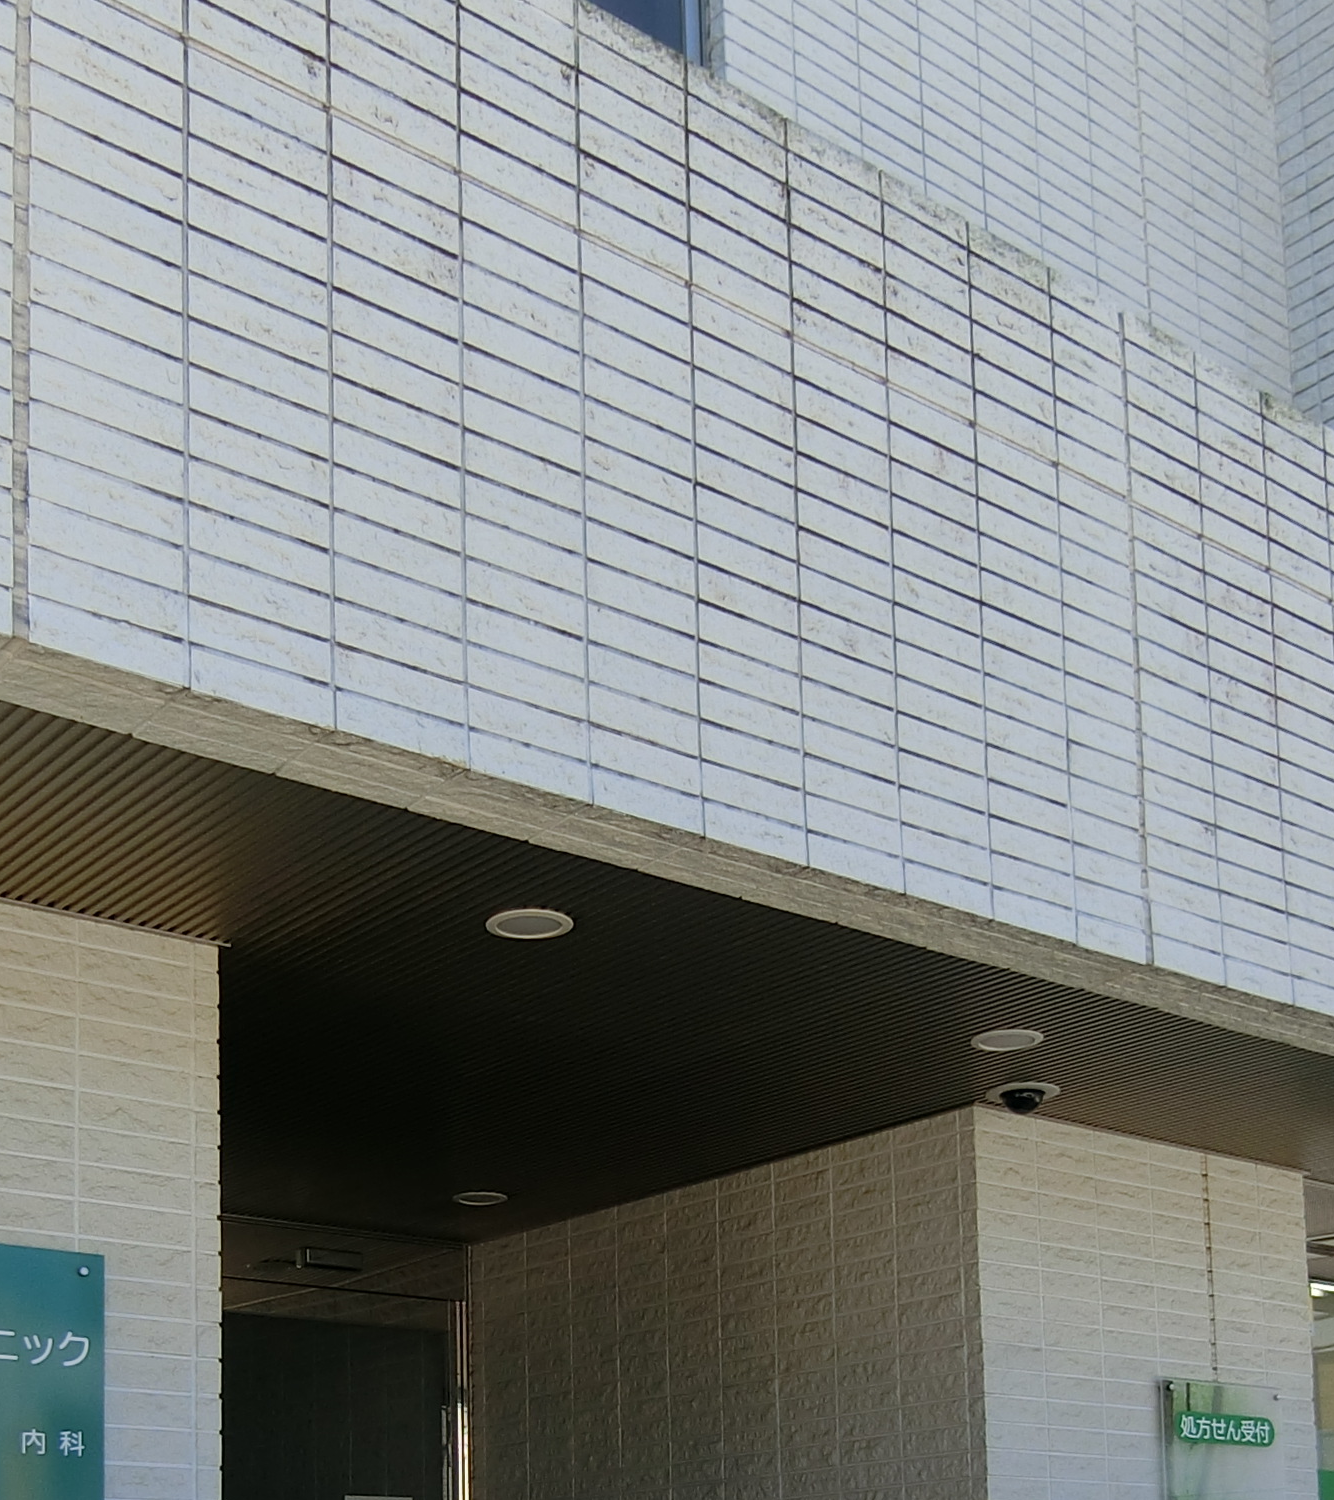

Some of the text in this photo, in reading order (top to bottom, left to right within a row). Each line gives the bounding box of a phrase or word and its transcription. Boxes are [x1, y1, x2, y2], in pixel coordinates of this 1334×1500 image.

[21, 1429, 84, 1457] 内科
[1180, 1414, 1270, 1444] 処方せん受付
